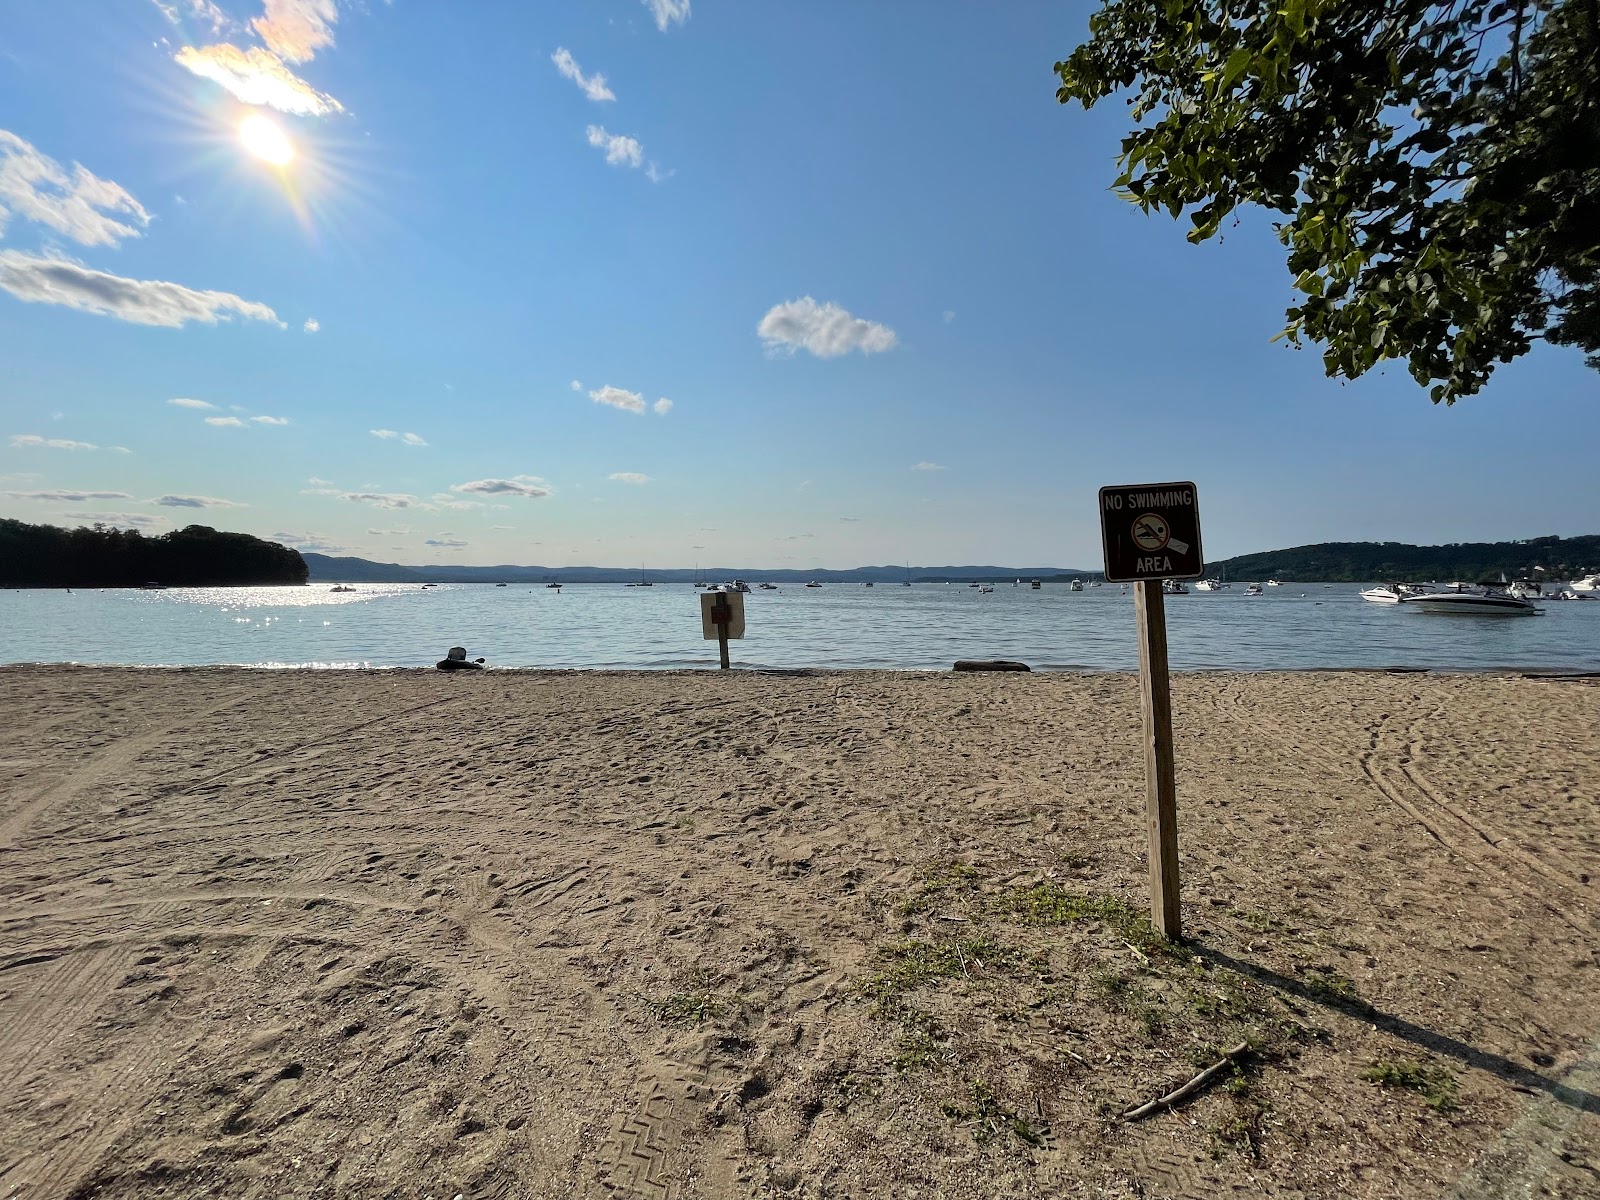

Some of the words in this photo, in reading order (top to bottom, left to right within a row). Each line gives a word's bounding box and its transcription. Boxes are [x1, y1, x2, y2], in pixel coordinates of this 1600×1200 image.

[1105, 495, 1123, 510] NO
[1128, 490, 1192, 508] SWIMMING
[1136, 556, 1172, 573] AREA
